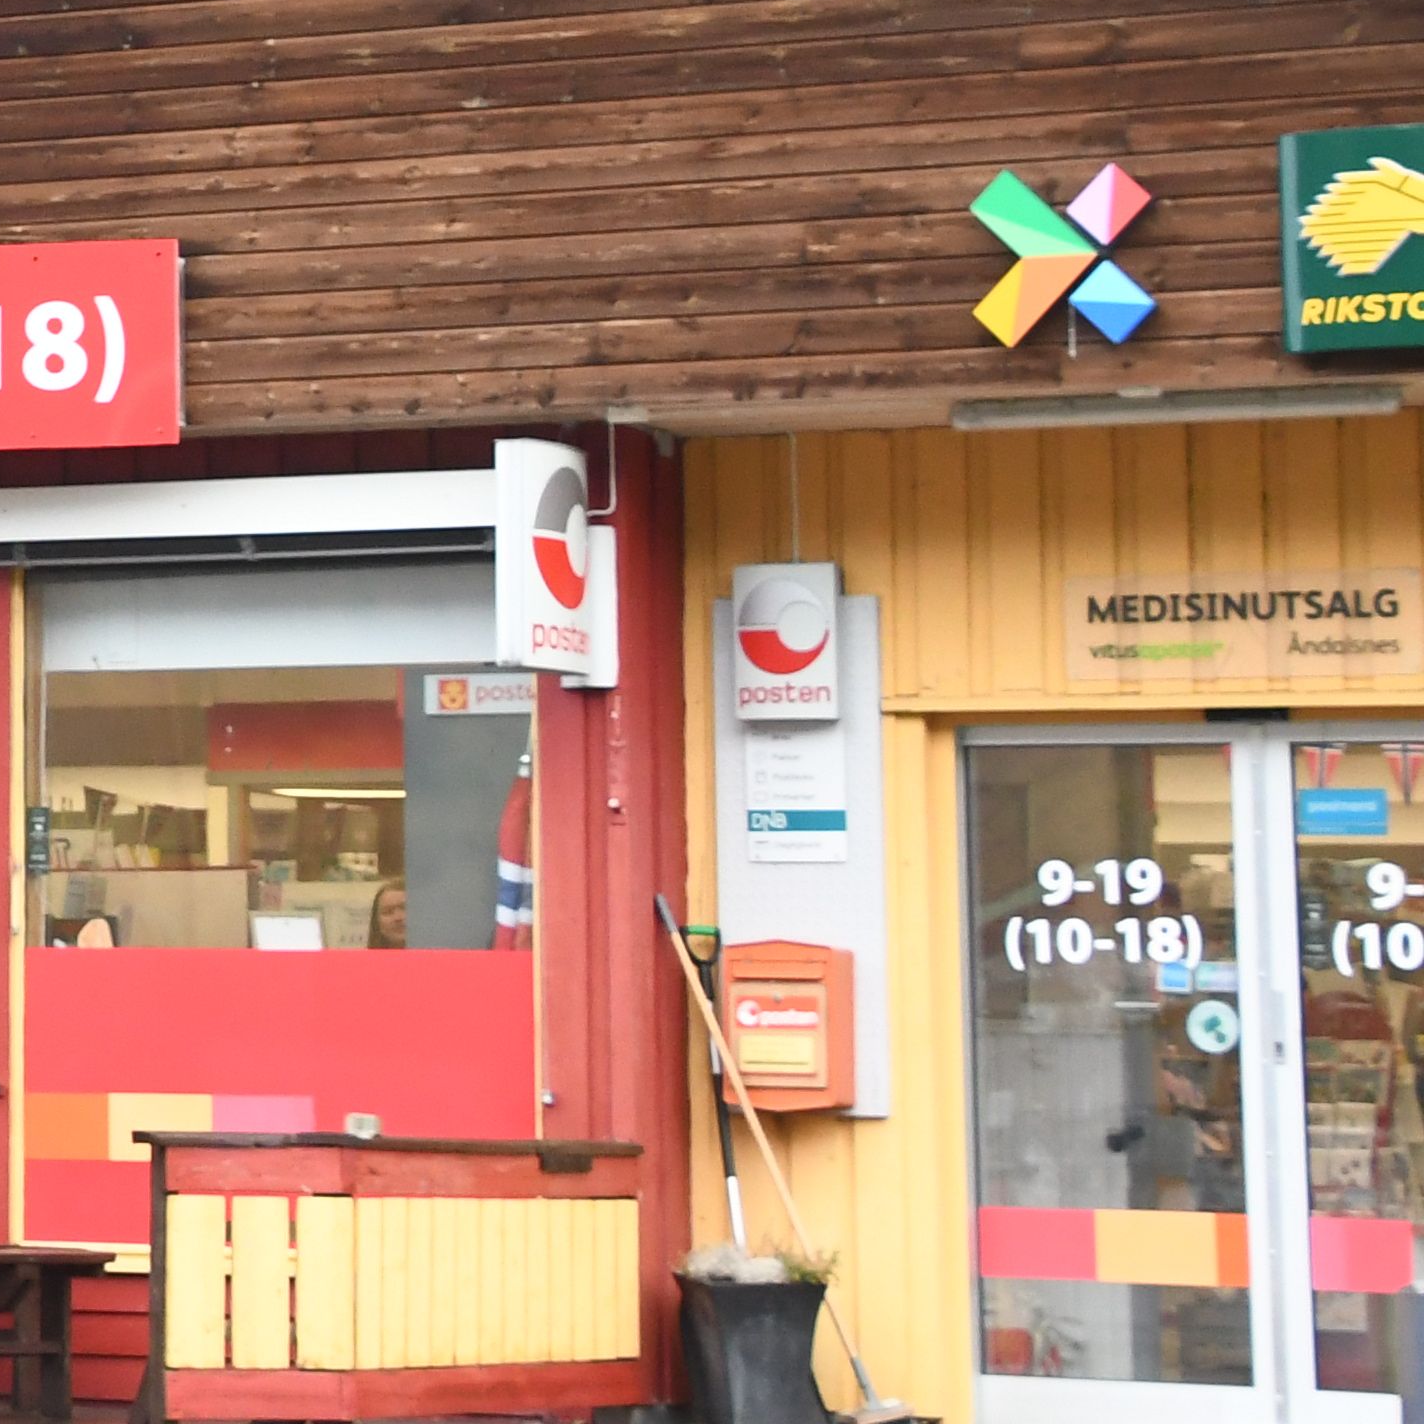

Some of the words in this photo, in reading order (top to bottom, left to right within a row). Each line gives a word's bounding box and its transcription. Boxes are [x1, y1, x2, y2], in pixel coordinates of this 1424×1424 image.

[1087, 588, 1400, 624] MEDISINUTSALG
[1288, 632, 1401, 656] Åndalsnes
[477, 683, 537, 703] poste
[739, 682, 831, 707] posten
[1037, 858, 1164, 906] 9-19
[1004, 914, 1203, 971] (10-18)
